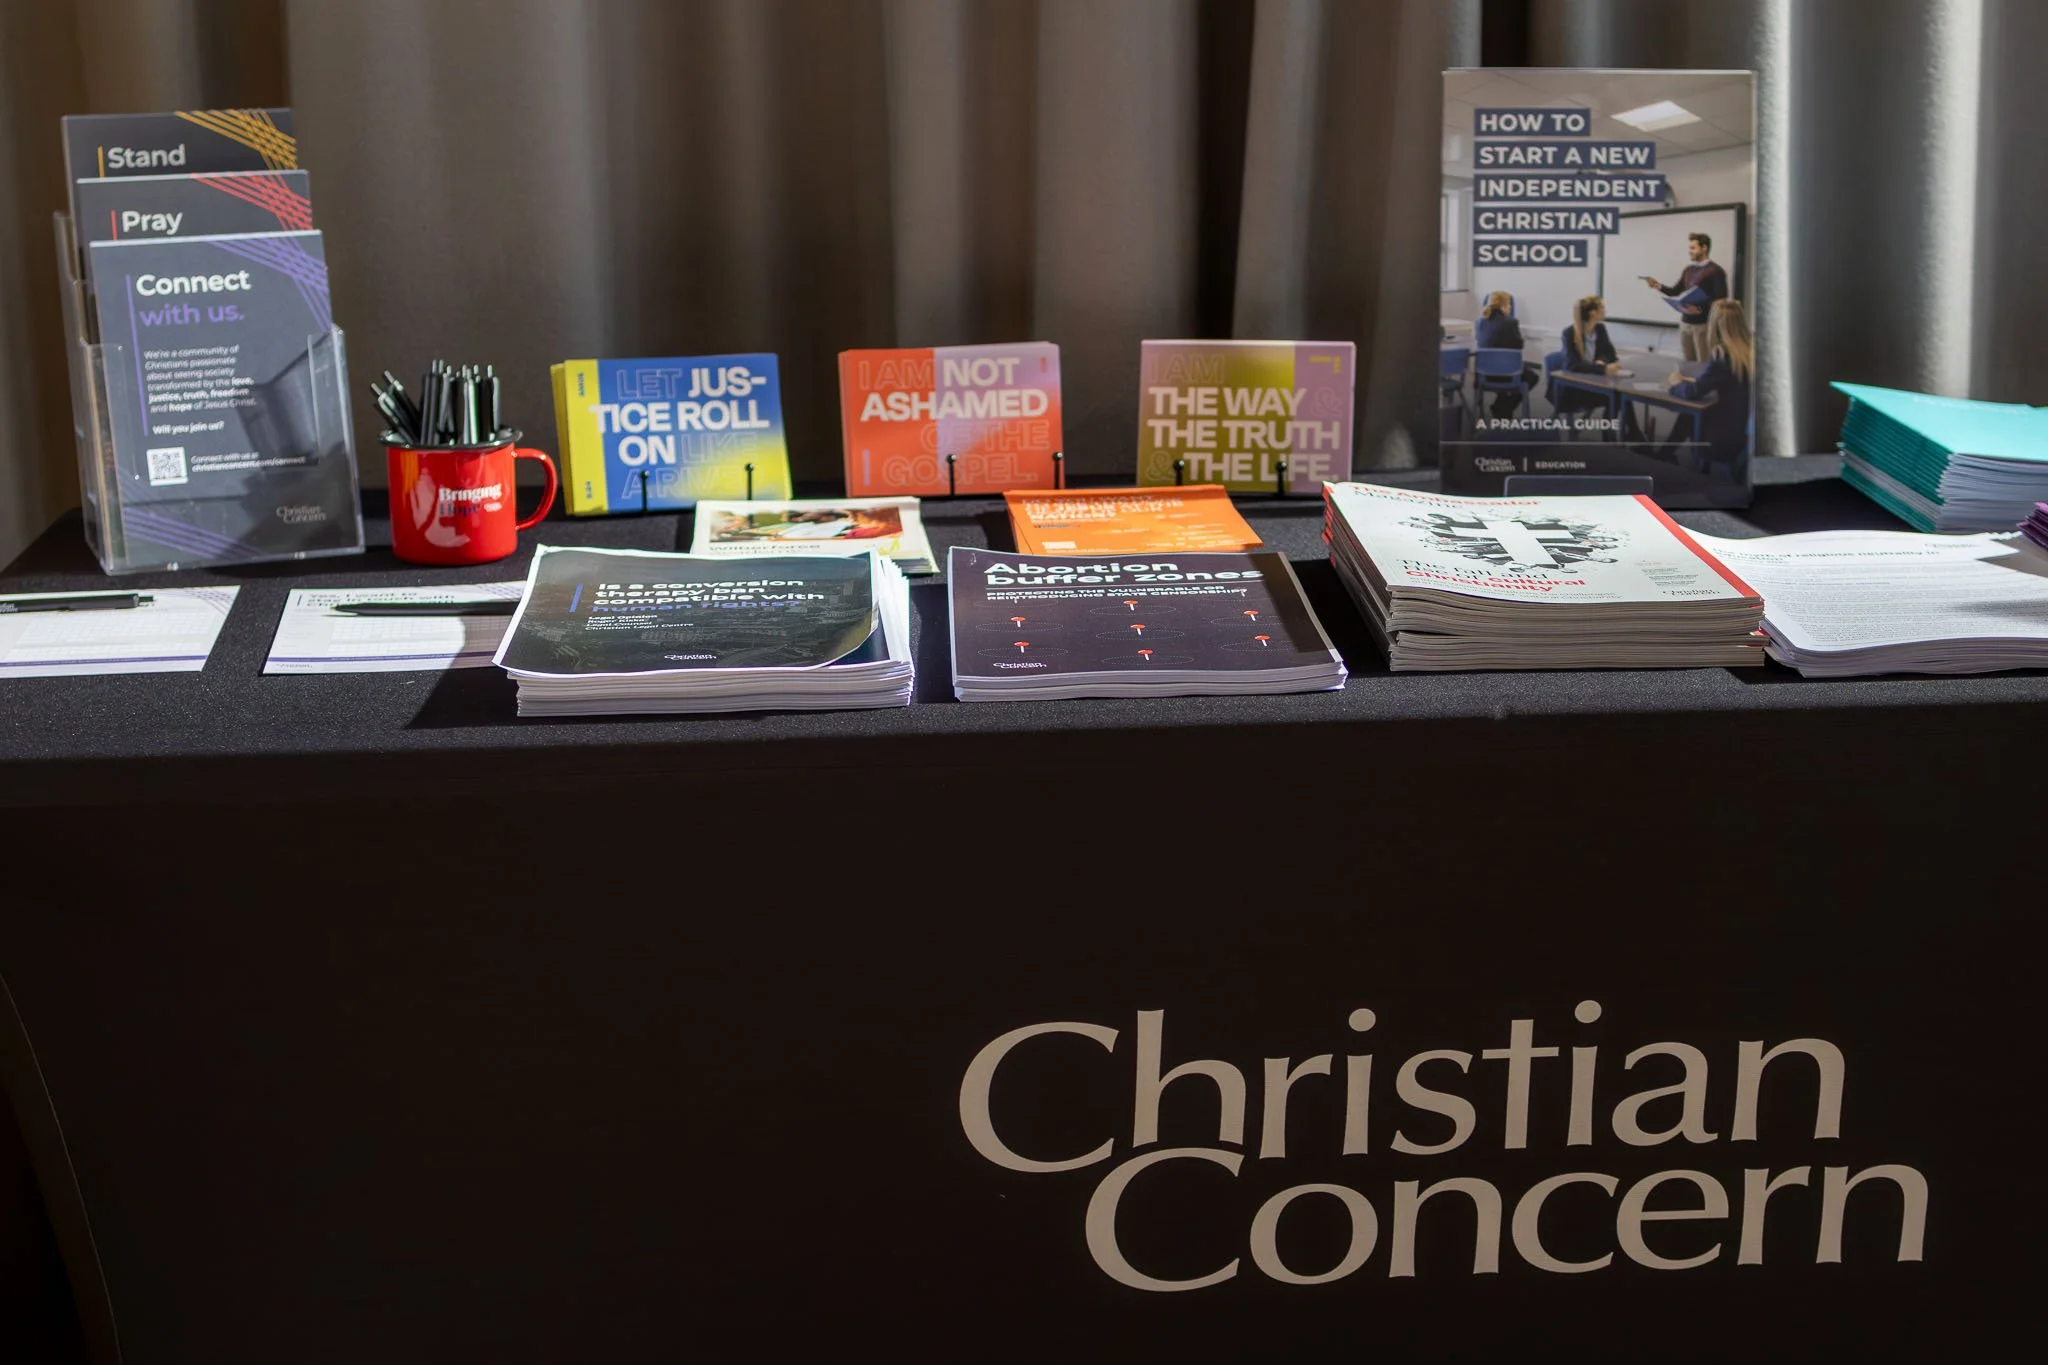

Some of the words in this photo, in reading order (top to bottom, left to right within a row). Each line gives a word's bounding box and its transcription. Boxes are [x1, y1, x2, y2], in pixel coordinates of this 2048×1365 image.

[1479, 113, 1544, 133] HOW
[1551, 113, 1586, 133] TO
[107, 144, 186, 169] Stand
[1478, 146, 1558, 166] START
[1564, 146, 1583, 165] A
[1590, 146, 1651, 166] NEW
[1478, 178, 1661, 198] INDEPENDENT
[122, 210, 182, 235] Pray
[1478, 211, 1614, 231] CHRISTIAN
[1477, 243, 1583, 263] SCHOOL
[136, 269, 251, 297] Connect
[139, 302, 201, 327] with
[207, 303, 245, 324] us.
[143, 349, 170, 360] We're
[178, 346, 229, 358] community
[229, 344, 240, 354] of
[144, 360, 189, 370] Christians
[190, 357, 237, 369] passionate
[1165, 352, 1226, 384] AM
[146, 371, 173, 382] about
[173, 370, 203, 380] seeing
[204, 367, 235, 378] society
[616, 367, 682, 400] LET
[688, 366, 767, 398] JUS-
[857, 360, 870, 391] I
[873, 358, 936, 390] AM
[943, 357, 1021, 387] NOT
[147, 380, 203, 392] transformed
[203, 379, 214, 389] by
[215, 379, 230, 387] the
[231, 377, 255, 386] love,
[148, 392, 182, 404] justice,
[183, 390, 210, 400] truth,
[210, 388, 250, 398] freedom
[150, 403, 168, 413] and
[169, 402, 193, 413] hope
[194, 401, 204, 410] of
[204, 400, 229, 410] Jesus
[229, 398, 257, 408] Christ.
[860, 388, 1049, 423] ASHAMED
[1148, 387, 1219, 416] THE
[1223, 387, 1308, 417] WAY
[588, 402, 671, 433] TICE
[677, 399, 770, 431] ROLL
[1475, 417, 1487, 431] A
[1490, 417, 1572, 431] PRACTICAL
[1574, 417, 1621, 431] GUIDE
[152, 424, 171, 435] Will
[171, 424, 190, 435] you
[190, 422, 208, 433] join
[208, 420, 225, 430] us?
[920, 421, 970, 452] OF
[980, 419, 1050, 451] THE
[1147, 419, 1218, 449] THE
[1222, 420, 1341, 450] TRUTH
[190, 454, 222, 465] Connect
[223, 453, 241, 463] with
[241, 453, 252, 461] us
[618, 435, 676, 466] ON
[681, 432, 760, 465] LIKE
[1183, 452, 1253, 482] THE
[1474, 456, 1513, 466] Christian
[1535, 460, 1586, 470] EDUCATION
[439, 483, 502, 504] Bringing
[621, 467, 652, 500] A
[276, 505, 322, 517] Christian
[283, 512, 327, 524] Concern
[984, 562, 1179, 575] Abortion
[986, 574, 1121, 585] buffer
[1133, 570, 1264, 582] zones
[1453, 567, 1493, 576] fall
[652, 579, 805, 589] conversion
[1405, 570, 1553, 592] Christianity
[1487, 577, 1587, 586] cultural
[593, 594, 755, 605] compatible
[595, 589, 706, 598] therapy
[987, 593, 1104, 601] REINTRODUCING
[1150, 589, 1249, 597] CENSORSHIP?
[591, 603, 693, 613] human
[700, 601, 801, 610] rights?
[958, 999, 1846, 1174] Christian
[1084, 1146, 1930, 1293] Concern
